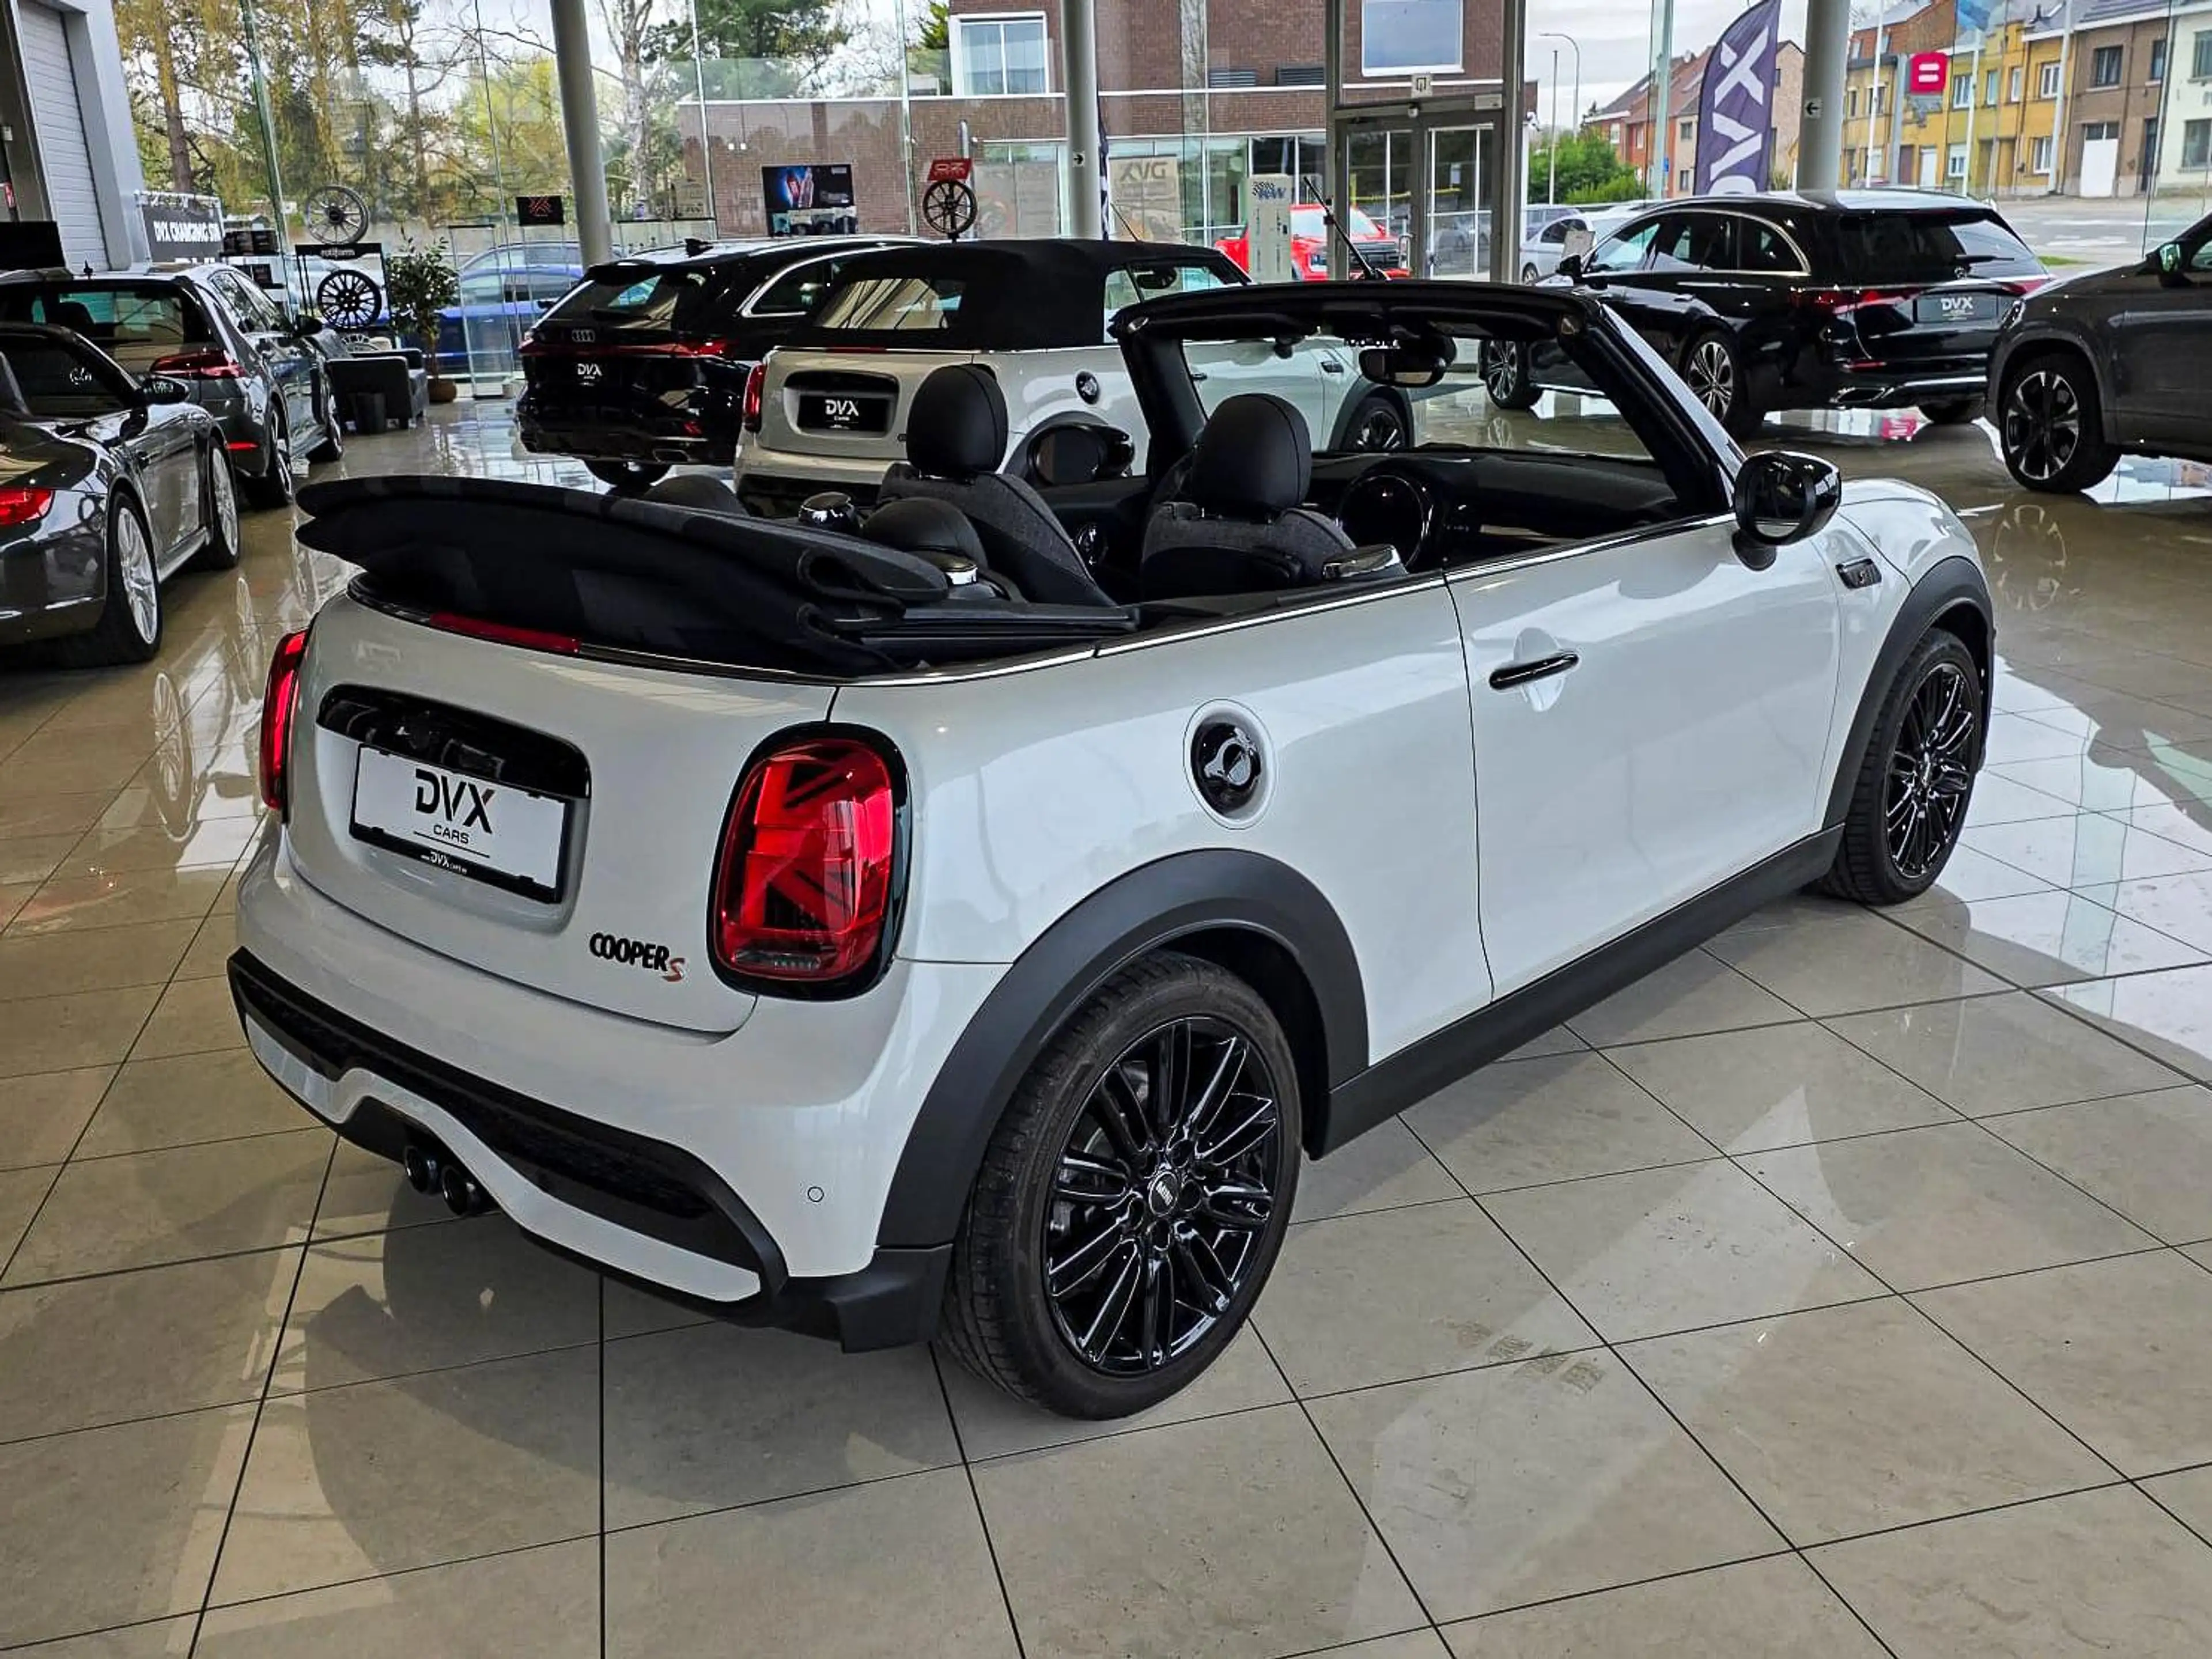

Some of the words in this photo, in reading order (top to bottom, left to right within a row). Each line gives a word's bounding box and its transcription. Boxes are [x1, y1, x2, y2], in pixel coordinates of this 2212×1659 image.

[1941, 296, 1973, 310] DVX
[577, 363, 603, 376] DVX
[825, 399, 859, 416] DVX
[415, 768, 495, 835] DVX
[433, 824, 469, 844] CARS
[589, 932, 670, 972] COOPER
